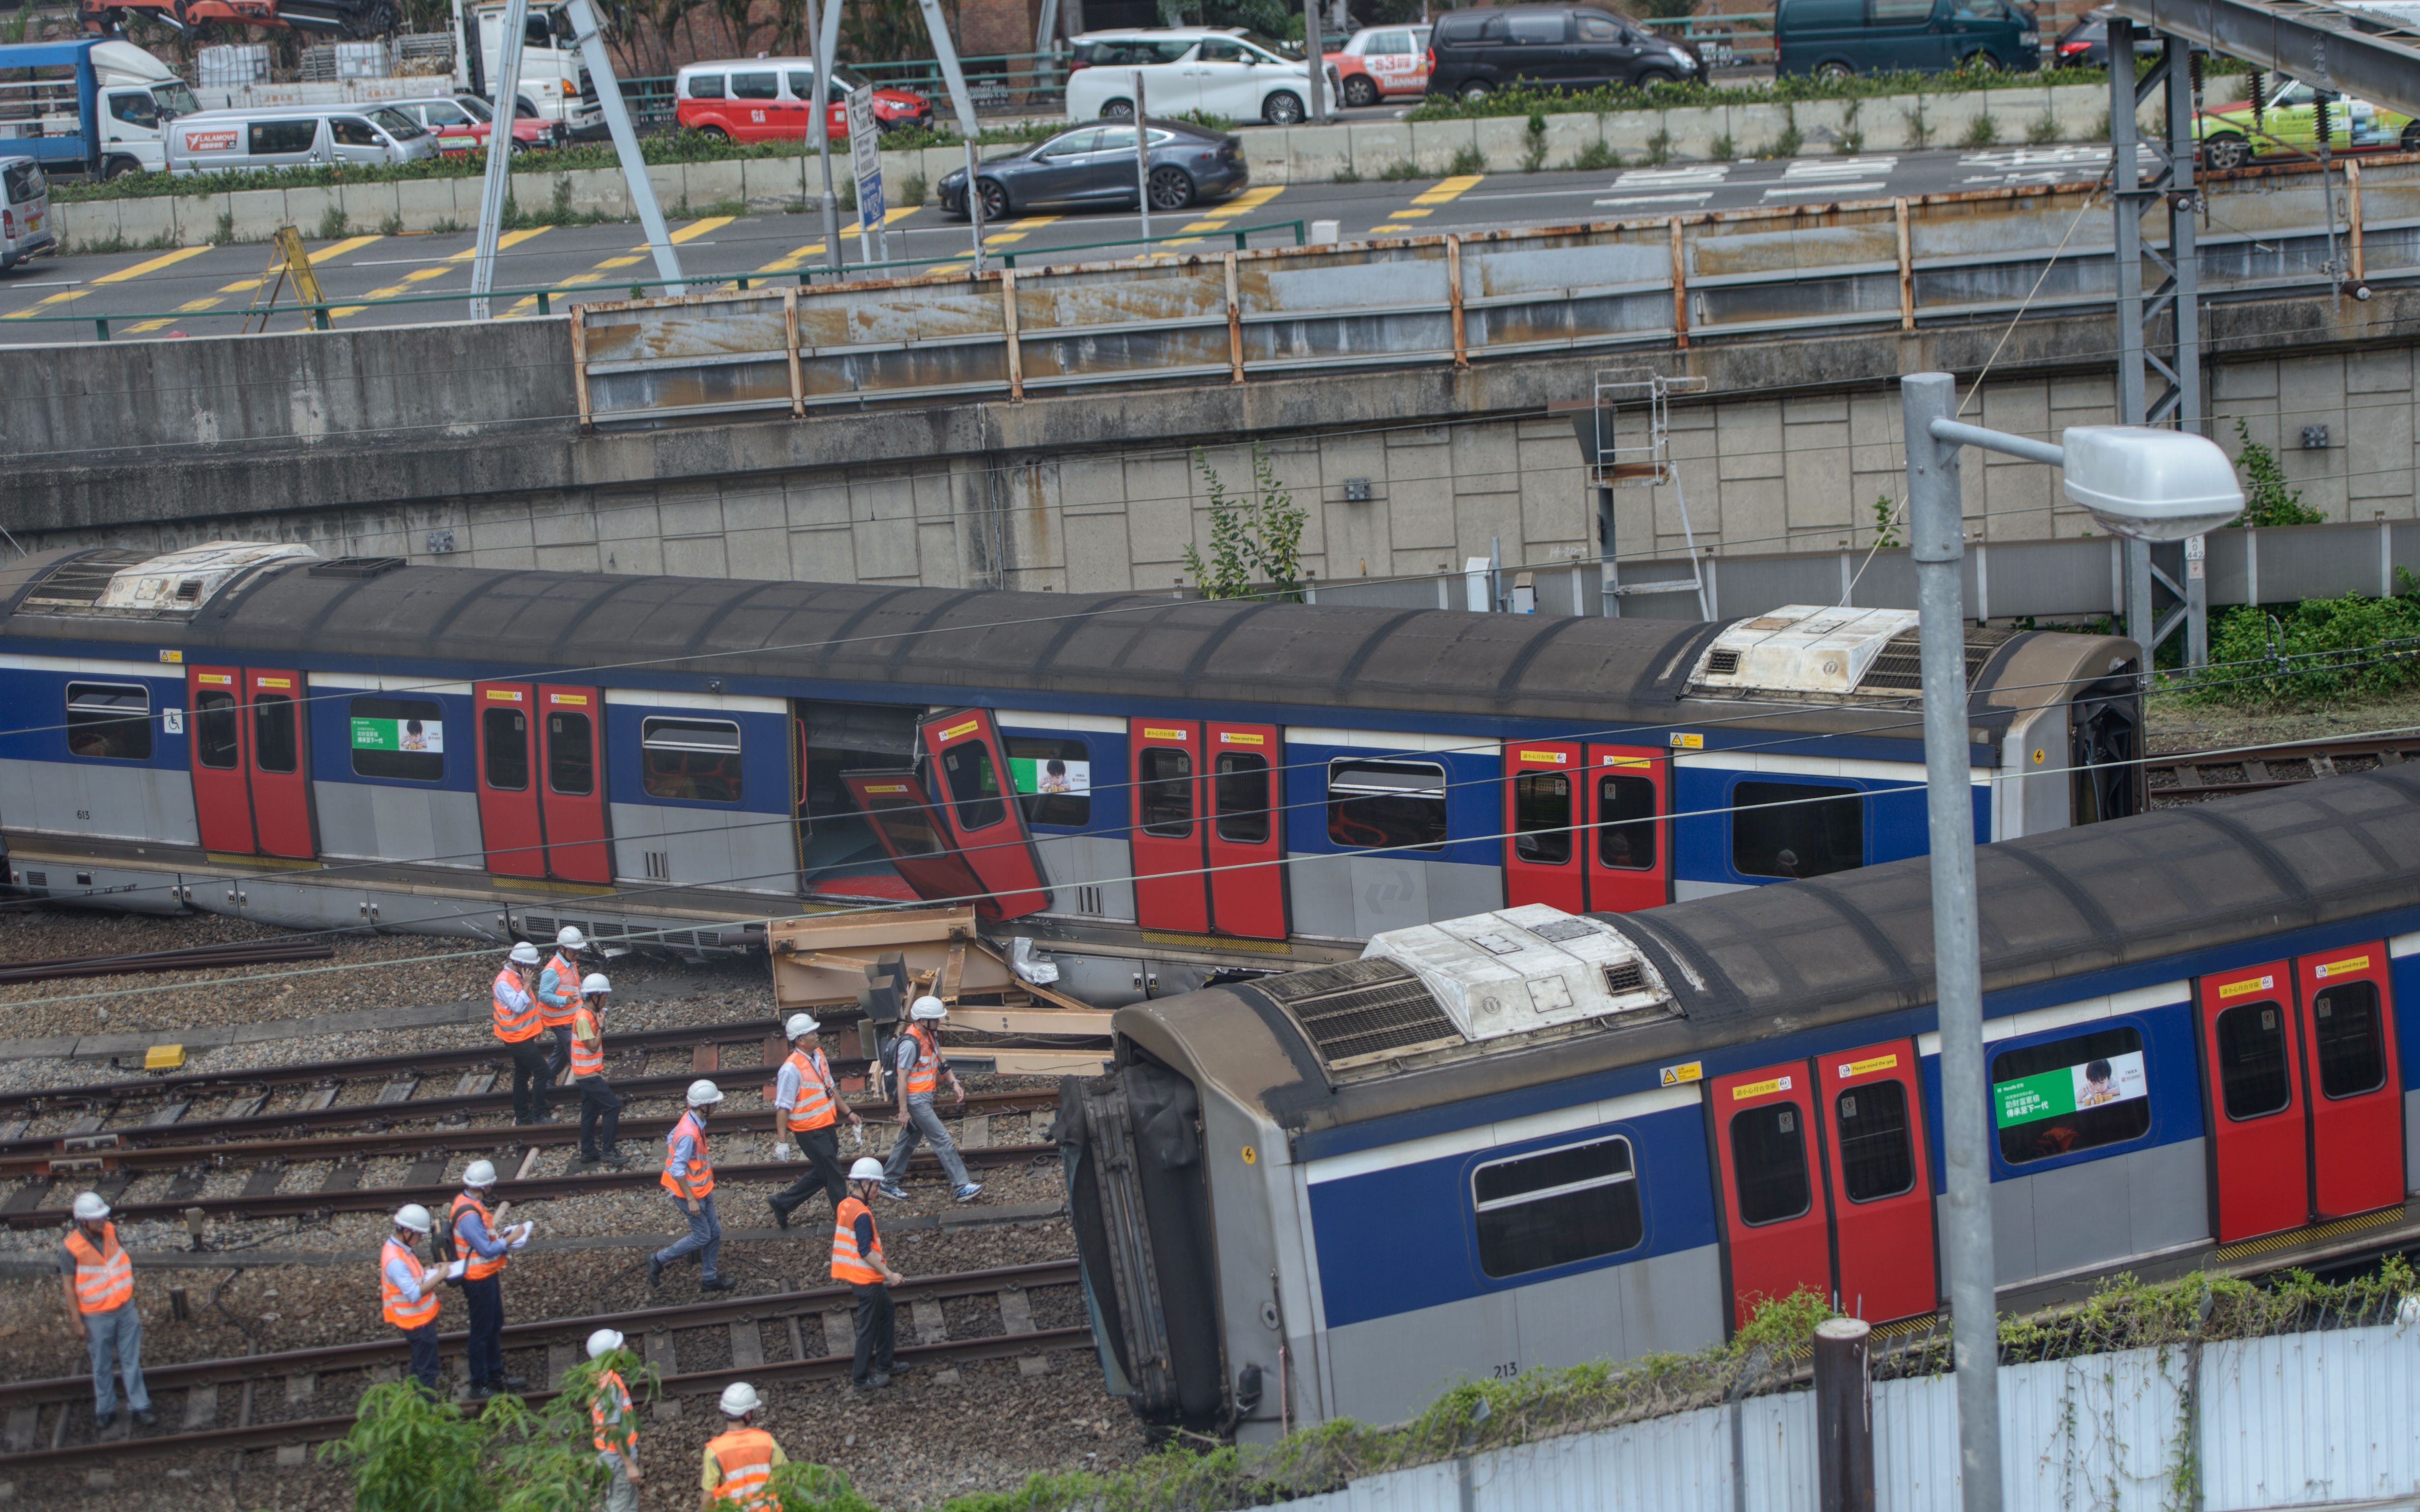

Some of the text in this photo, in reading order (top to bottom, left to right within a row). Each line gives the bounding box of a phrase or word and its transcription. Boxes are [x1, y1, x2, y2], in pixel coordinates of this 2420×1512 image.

[78, 810, 89, 820] 613
[2223, 982, 2259, 995] 請小心月台空隙
[1736, 1082, 1776, 1097] 請小心月台空隙
[2006, 1094, 2040, 1109] 助財富累積
[2007, 1101, 2049, 1118] 傳承至下一代
[1494, 1362, 1517, 1379] 213
